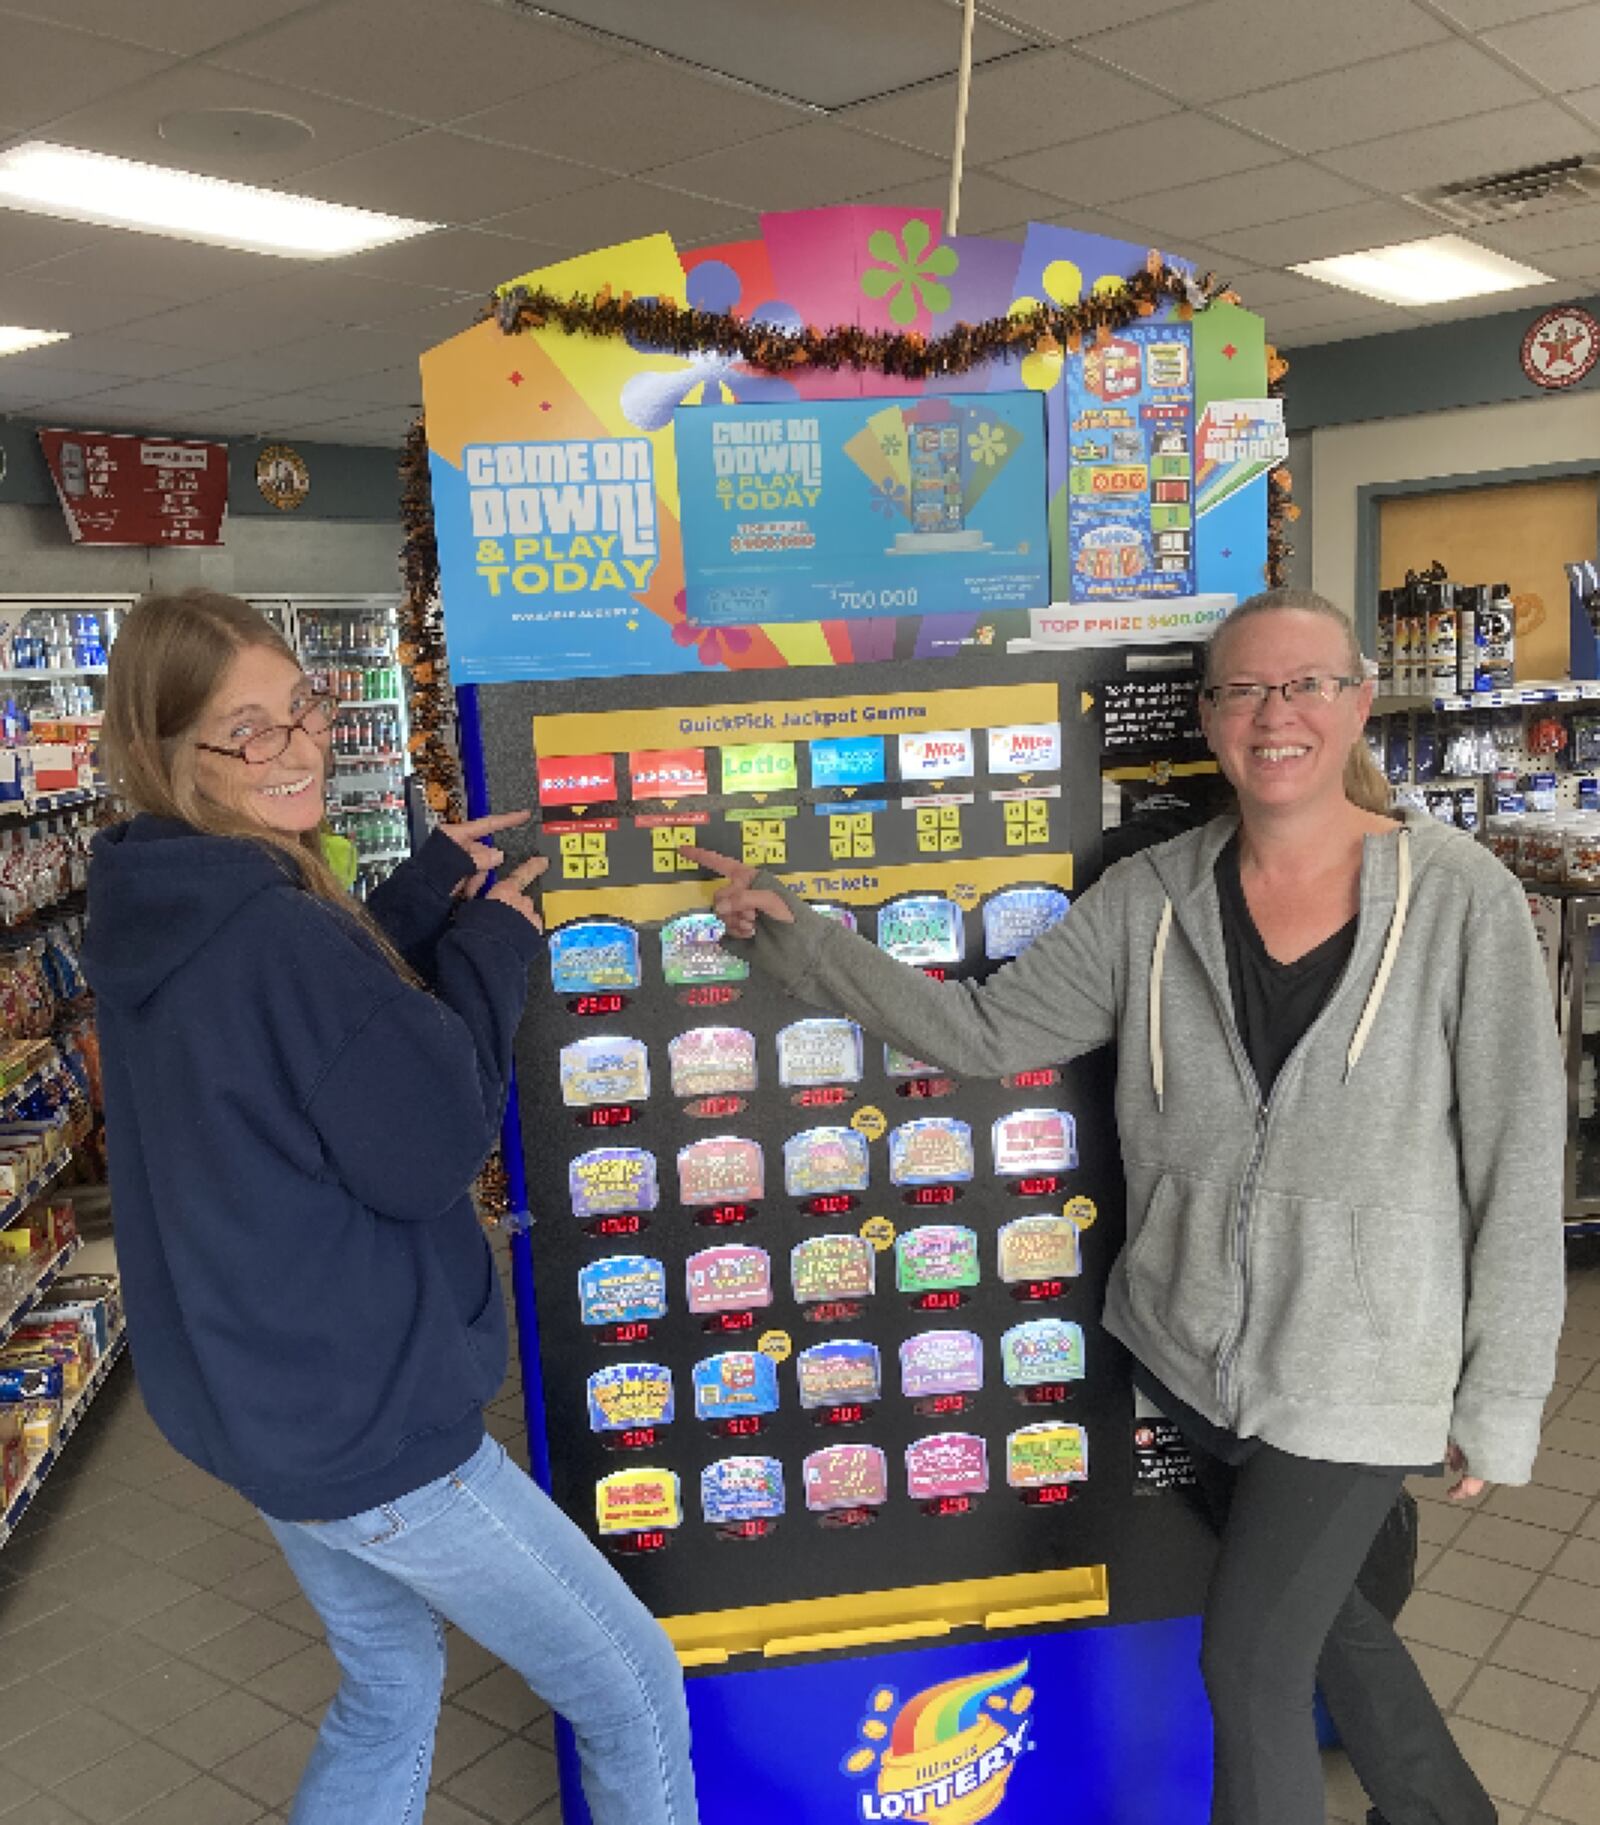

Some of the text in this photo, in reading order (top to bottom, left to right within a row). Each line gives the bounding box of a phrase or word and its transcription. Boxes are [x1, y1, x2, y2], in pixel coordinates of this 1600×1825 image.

[466, 439, 650, 486] COME ON
[738, 473, 798, 491] PLAY
[716, 488, 822, 511] TODAY
[469, 482, 656, 556] DOWN!
[476, 534, 618, 563] & PLAY
[476, 559, 654, 596] TODAY
[1040, 619, 1080, 633] TOP
[1084, 617, 1143, 632] PRIZE
[679, 712, 775, 735] QuickPick
[781, 707, 858, 728] Jackpot
[724, 753, 790, 777] Lotto
[812, 874, 880, 894] Tickets
[861, 1718, 1029, 1820] LOTTERY
